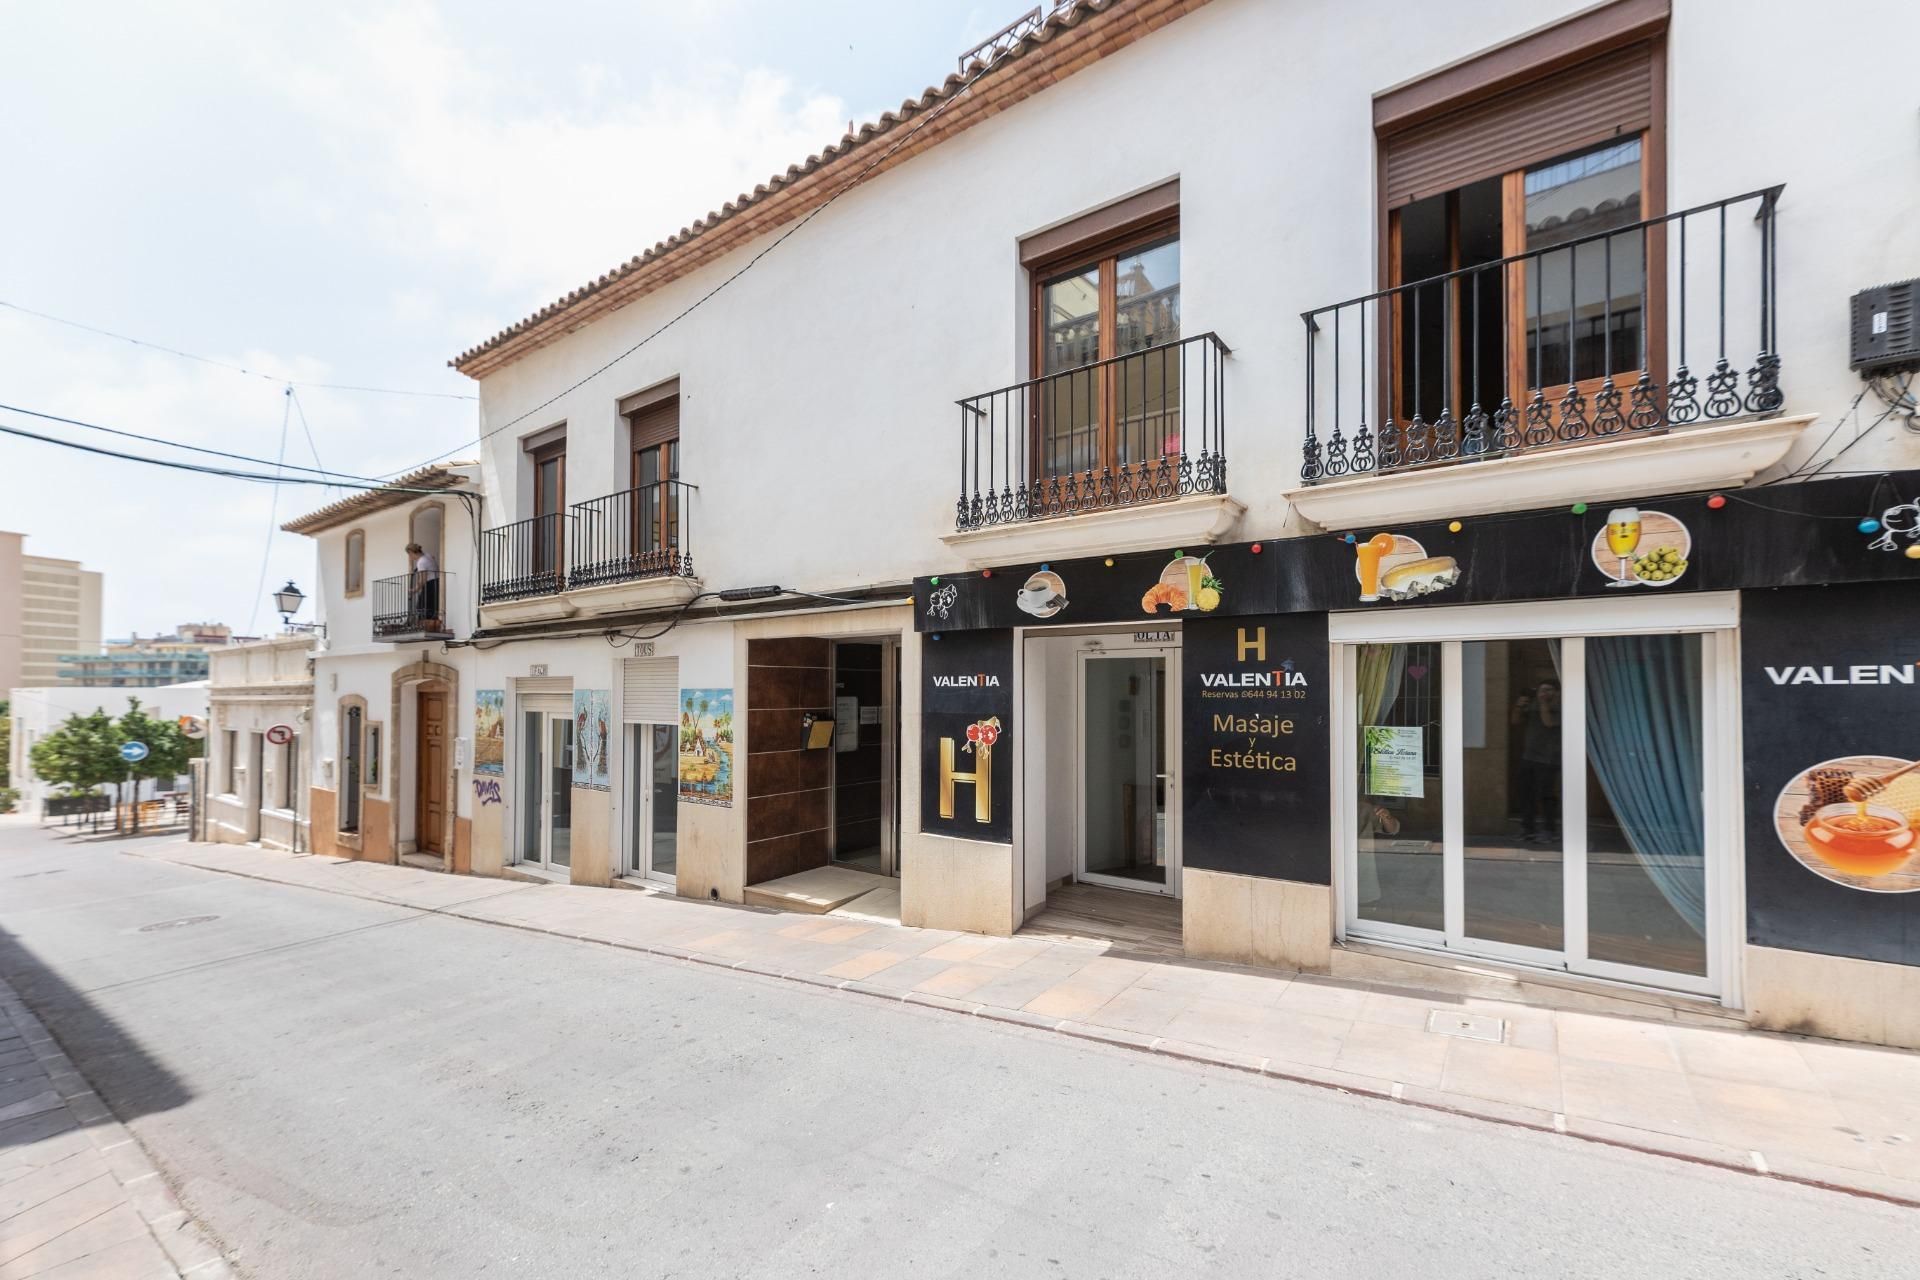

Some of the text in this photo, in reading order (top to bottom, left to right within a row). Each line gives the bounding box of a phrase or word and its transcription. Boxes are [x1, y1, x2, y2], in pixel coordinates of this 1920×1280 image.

[1237, 626, 1266, 662] H
[933, 674, 1000, 687] VALENTIA
[1200, 670, 1308, 687] VALENTIA
[1763, 660, 1920, 685] VALEN
[1202, 690, 1239, 699] Reservas
[1266, 690, 1278, 698] 94
[1281, 690, 1292, 699] 13
[1294, 690, 1306, 699] 02
[1213, 714, 1294, 738] Masaje
[1248, 737, 1256, 748] y
[1211, 749, 1297, 771] Estética
[939, 737, 991, 823] H
